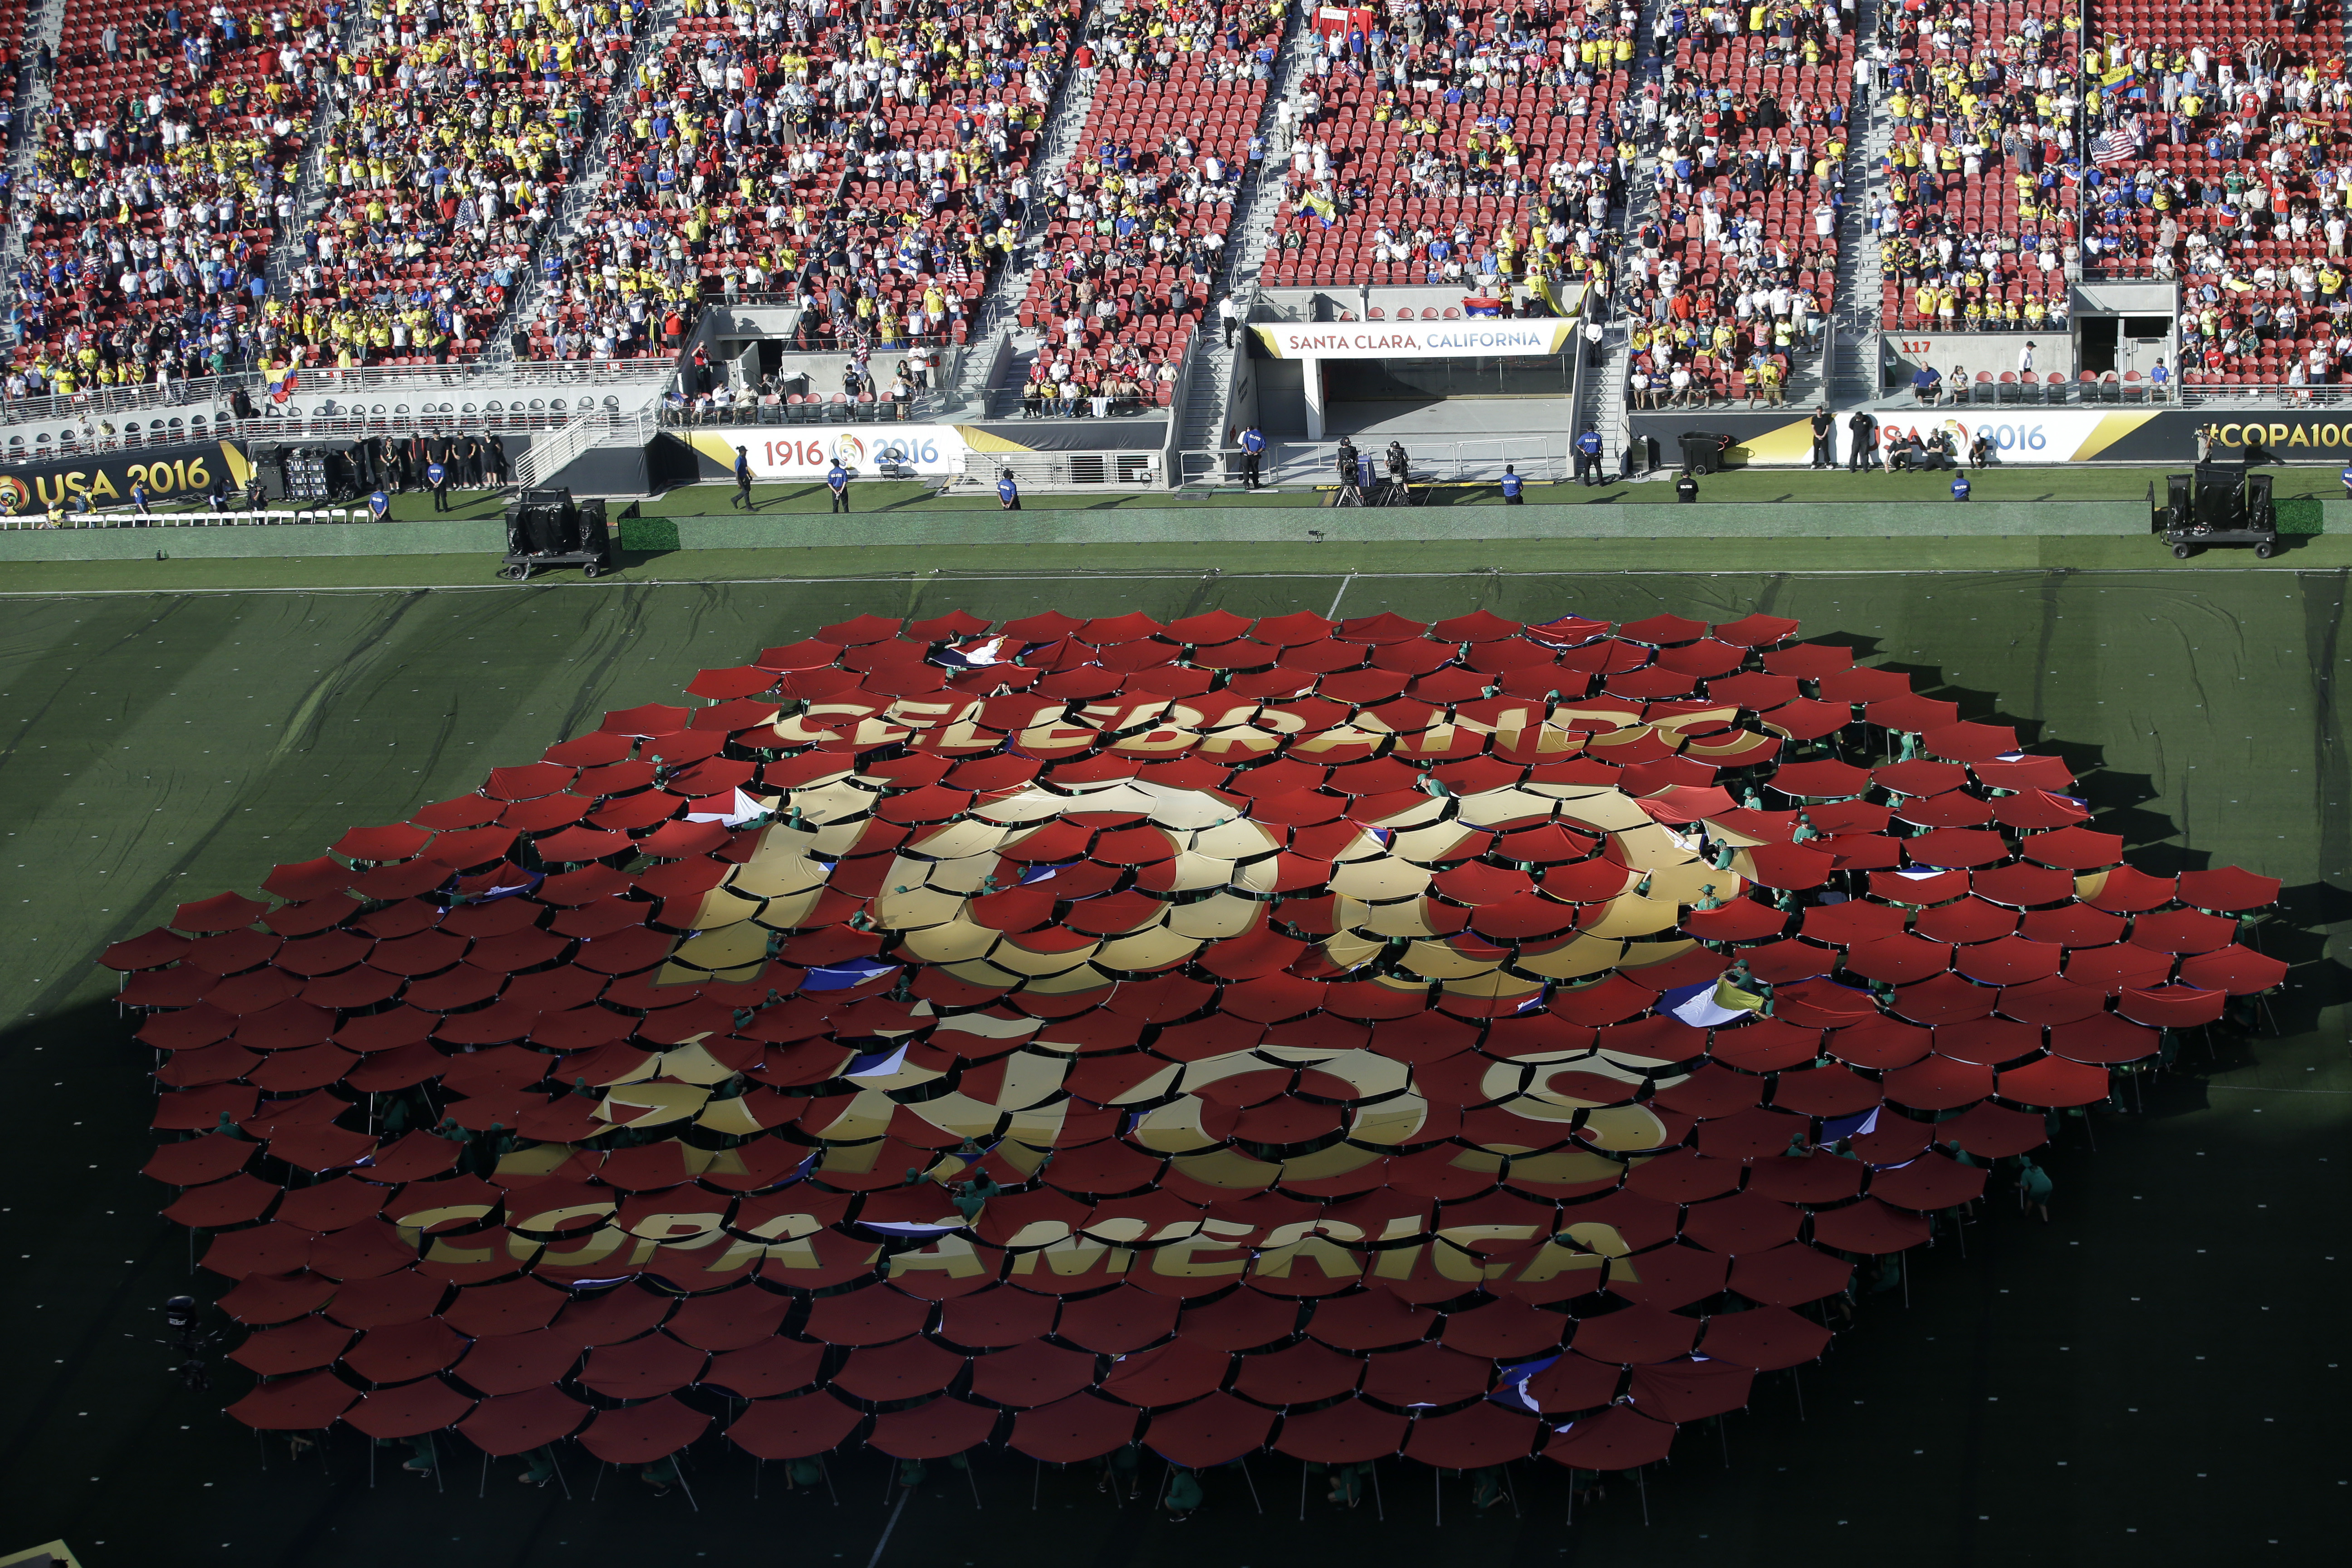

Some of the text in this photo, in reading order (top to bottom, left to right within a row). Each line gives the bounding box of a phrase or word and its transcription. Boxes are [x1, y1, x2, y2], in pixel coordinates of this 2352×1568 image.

[1645, 103, 1654, 114] 10
[1289, 332, 1541, 351] SANTA CLARA, CALIFORNIA
[1901, 341, 1931, 353] 117
[764, 438, 938, 466] 1916 2016
[35, 456, 211, 506] USA 2016
[757, 699, 1784, 756] CELEBRANDO
[647, 778, 1759, 996] 100
[396, 1201, 1643, 1284] COPA AMERICA
